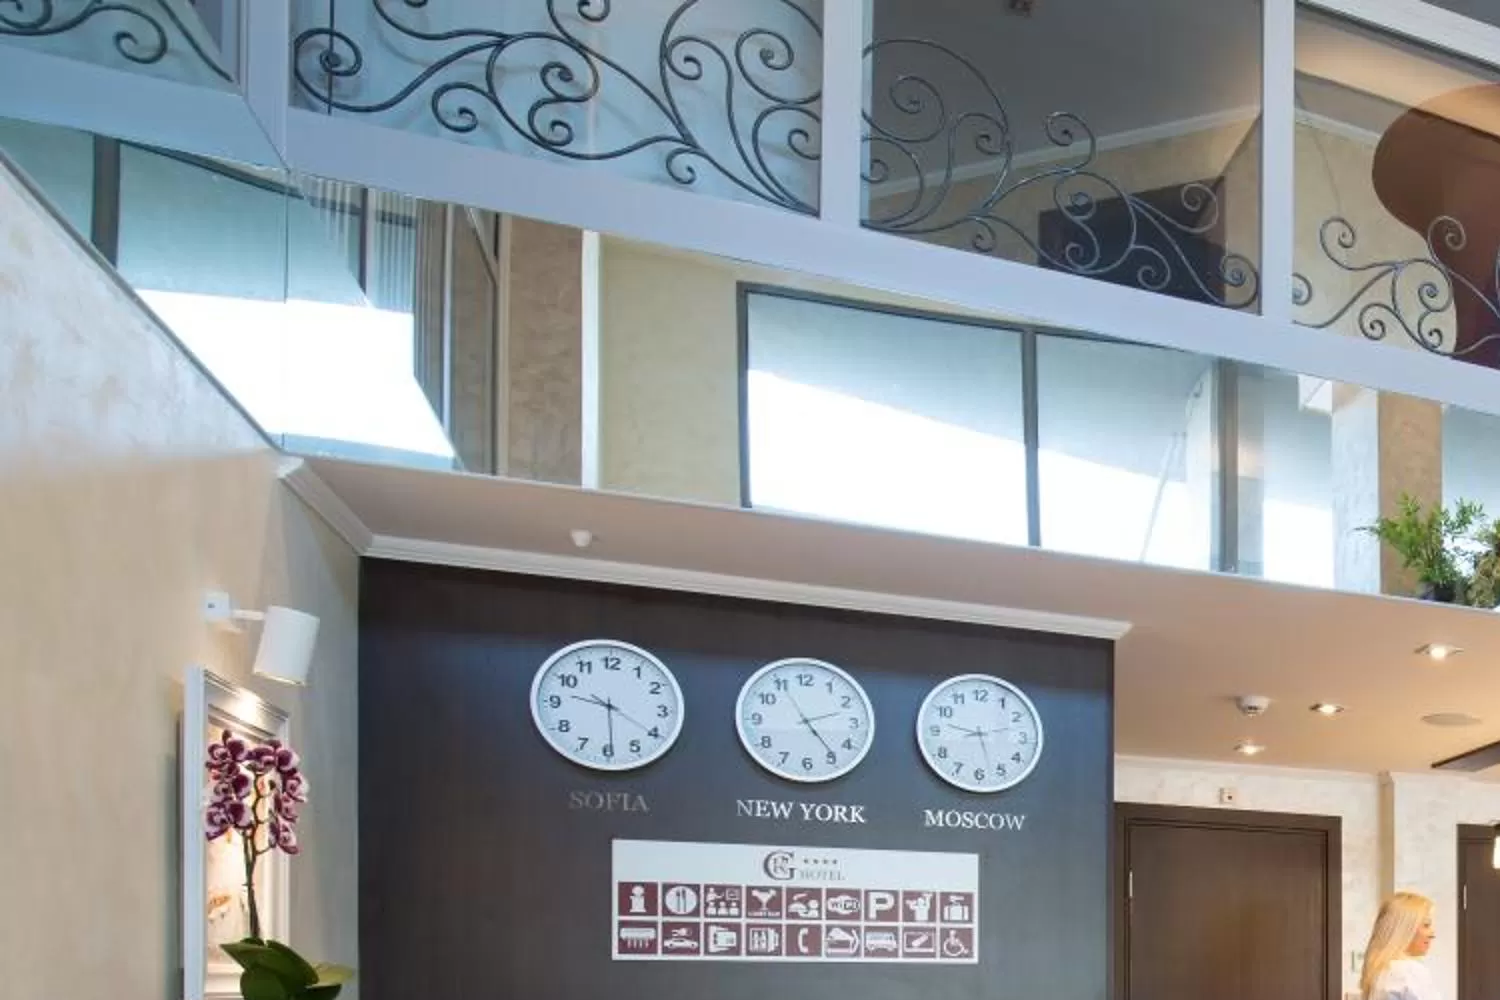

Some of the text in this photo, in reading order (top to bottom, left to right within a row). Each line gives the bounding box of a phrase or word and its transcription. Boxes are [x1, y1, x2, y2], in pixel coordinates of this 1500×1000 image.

[576, 661, 592, 674] 11
[603, 657, 620, 671] 12
[634, 666, 641, 680] 1
[558, 674, 578, 688] 10
[774, 679, 788, 692] 11
[796, 674, 814, 687] 12
[650, 682, 661, 695] 2
[826, 682, 833, 695] 1
[549, 695, 561, 709] 9
[759, 692, 776, 705] 10
[841, 696, 851, 708] 2
[952, 693, 965, 705] 11
[973, 689, 989, 702] 12
[998, 697, 1005, 709] 1
[657, 705, 669, 718] 3
[939, 706, 953, 718] 10
[1012, 711, 1021, 723] 2
[751, 712, 763, 725] 9
[850, 717, 859, 730] 3
[558, 720, 570, 732] 8
[930, 724, 941, 736] 9
[647, 727, 659, 739] 4
[1018, 731, 1028, 744] 3
[578, 737, 589, 750] 7
[629, 740, 641, 752] 5
[761, 736, 772, 749] 8
[842, 740, 851, 751] 4
[779, 751, 789, 764] 7
[937, 748, 948, 760] 8
[1011, 751, 1021, 763] 4
[802, 757, 813, 770] 6
[954, 761, 964, 775] 7
[996, 763, 1006, 776] 5
[974, 767, 985, 781] 6
[569, 791, 650, 813] SOFIA
[737, 799, 866, 823] NEW YORK
[924, 810, 1027, 831] MOSCOW
[868, 891, 894, 919] P
